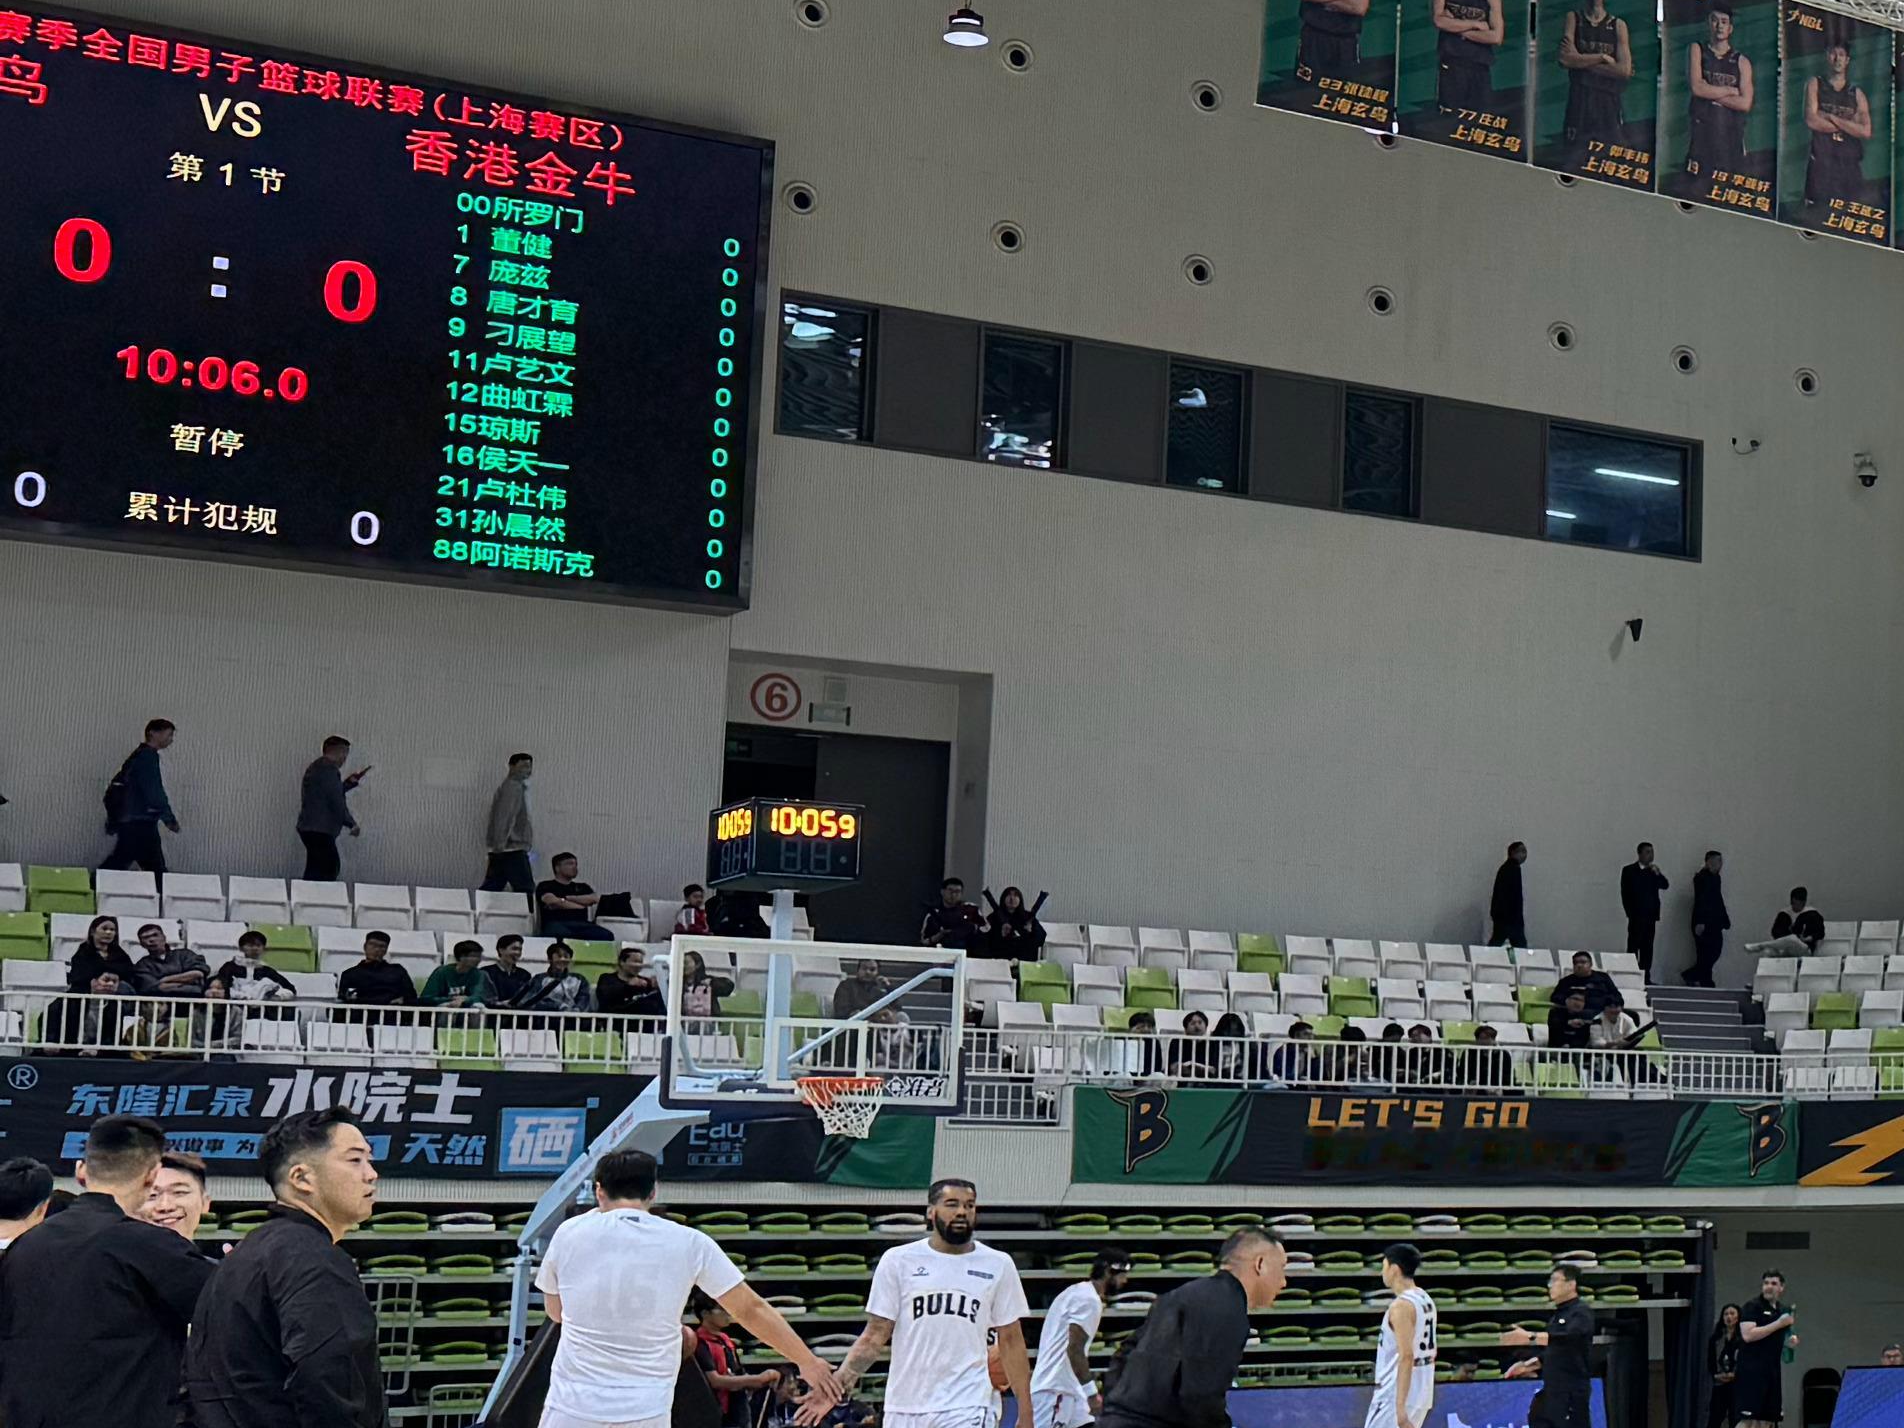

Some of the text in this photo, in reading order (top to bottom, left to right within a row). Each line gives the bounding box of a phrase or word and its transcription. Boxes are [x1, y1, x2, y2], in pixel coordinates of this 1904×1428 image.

[198, 93, 263, 139] VS
[405, 128, 637, 205] 香港金牛
[457, 224, 739, 287] 1 董健 0
[723, 238, 740, 257] 0
[54, 217, 112, 283] 0
[323, 259, 378, 324] 0
[453, 254, 737, 317] 7 庞兹 0
[450, 286, 735, 347] 8 唐才育 0
[448, 317, 733, 377] 9 刁展望 0
[116, 345, 309, 402] 10:06.0
[715, 388, 732, 407] 0
[170, 424, 245, 459] 暂停
[713, 418, 730, 437] 0
[711, 448, 728, 467] 0
[14, 471, 47, 508] 0
[710, 478, 727, 498] 0
[124, 492, 279, 539] 累计犯规
[350, 510, 380, 546] 0
[708, 509, 725, 528] 0
[706, 539, 723, 559] 0
[705, 569, 721, 589] 0
[765, 682, 788, 713] 6
[65, 1084, 253, 1118] 东隆汇泉
[1306, 1096, 1532, 1130] LET'S GO
[401, 1132, 487, 1166] 天然
[508, 1115, 580, 1166] 硒
[912, 1292, 982, 1325] BULLS
